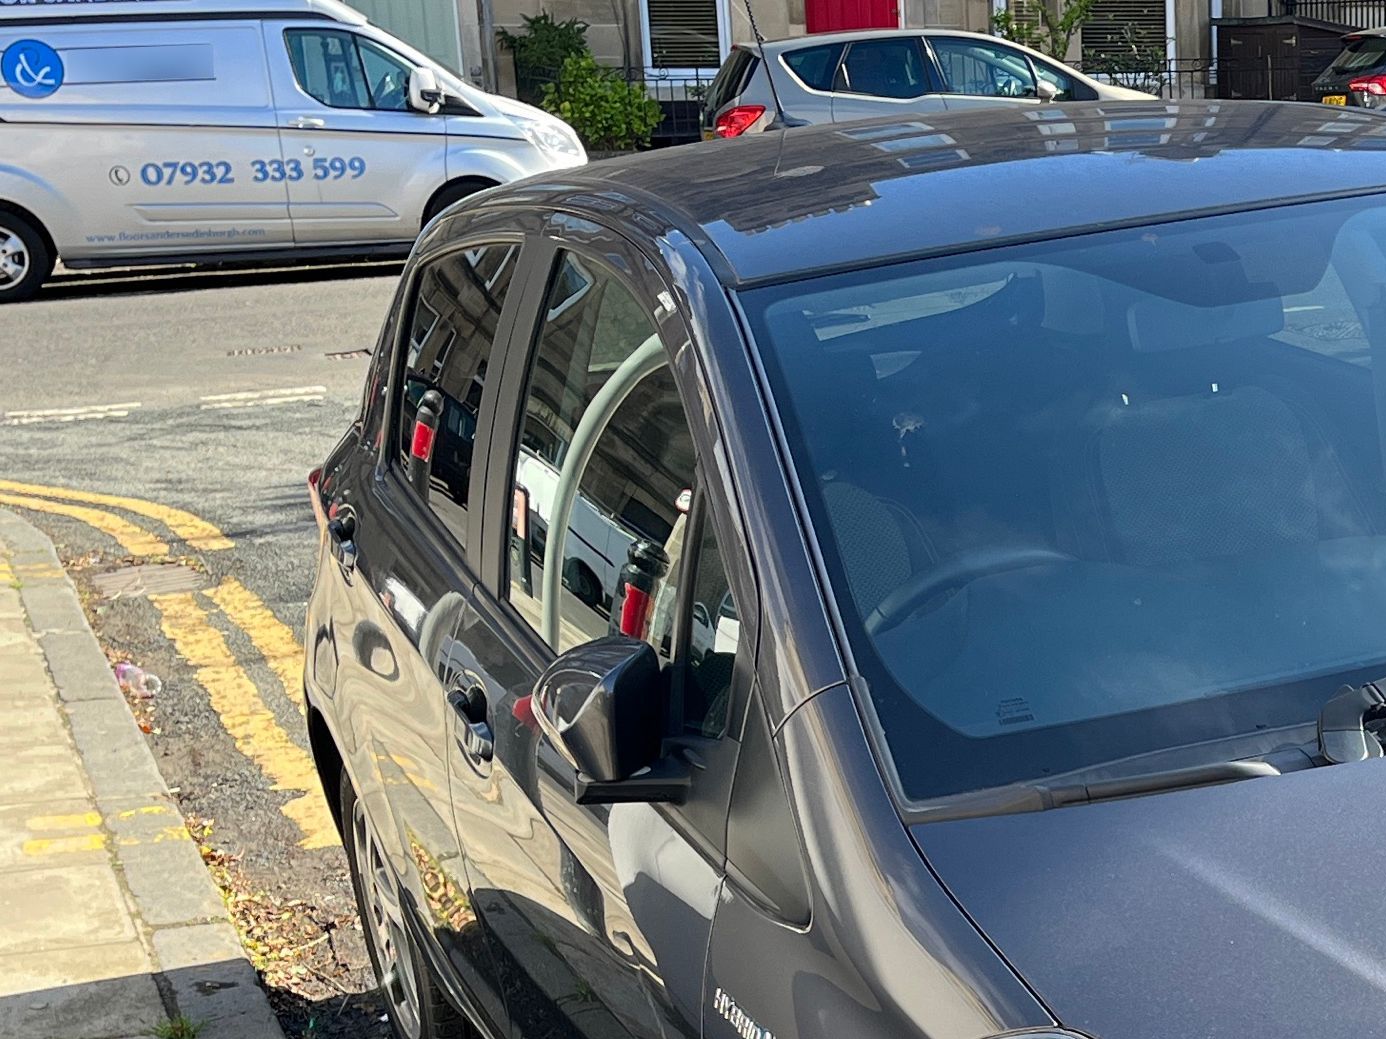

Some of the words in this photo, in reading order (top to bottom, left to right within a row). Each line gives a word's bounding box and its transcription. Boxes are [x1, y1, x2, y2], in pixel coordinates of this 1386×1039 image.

[140, 160, 235, 186] 07932
[250, 158, 304, 182] 333
[312, 156, 366, 181] 599
